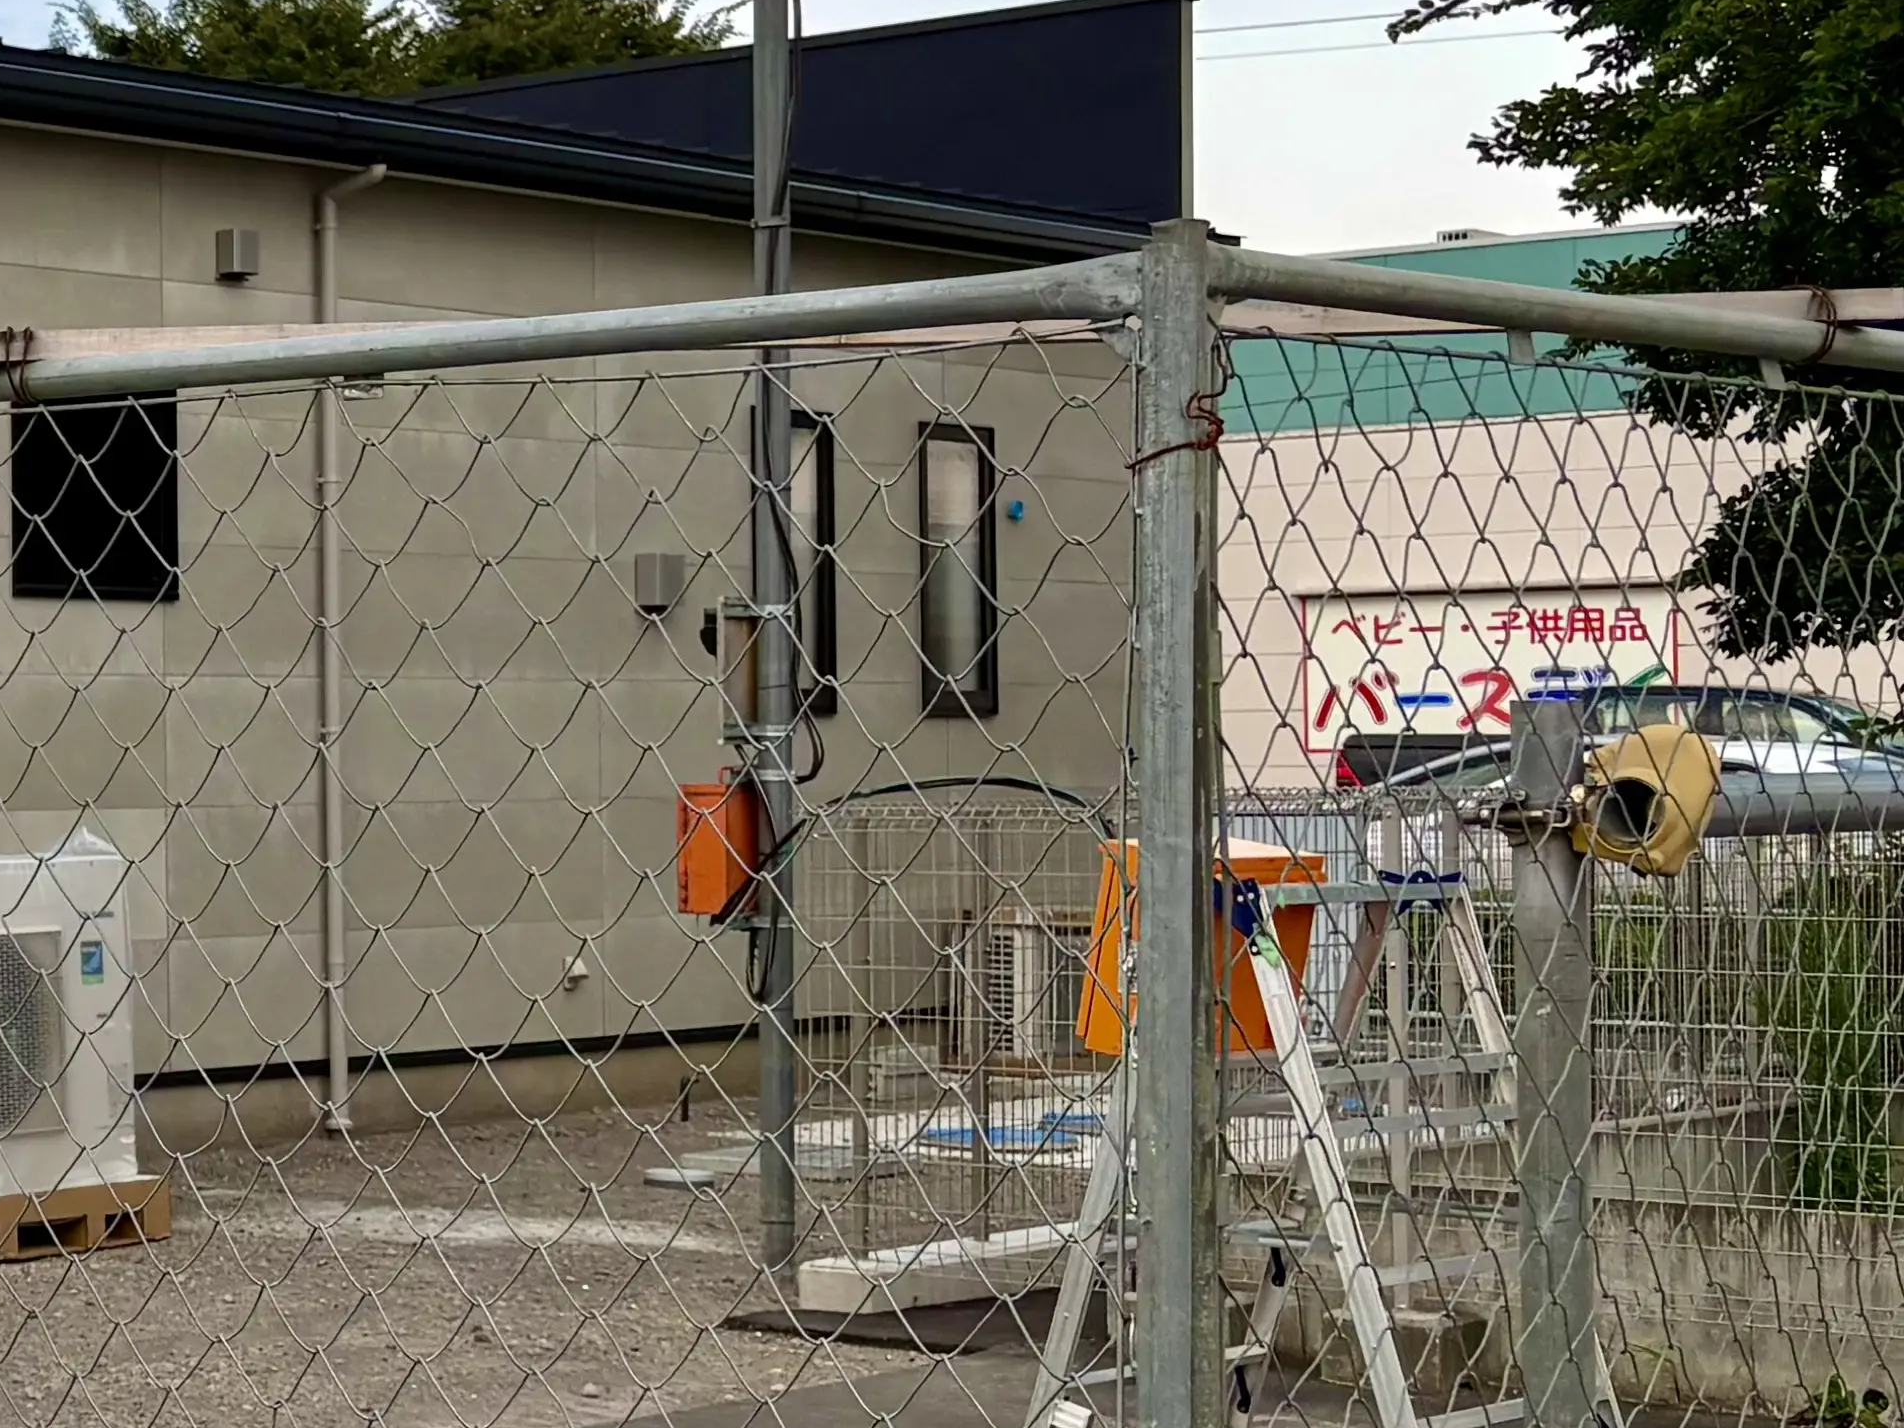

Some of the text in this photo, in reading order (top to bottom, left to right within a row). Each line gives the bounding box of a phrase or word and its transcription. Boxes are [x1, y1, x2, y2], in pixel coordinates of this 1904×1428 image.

[1331, 606, 1648, 645] ベビー・子供用品
